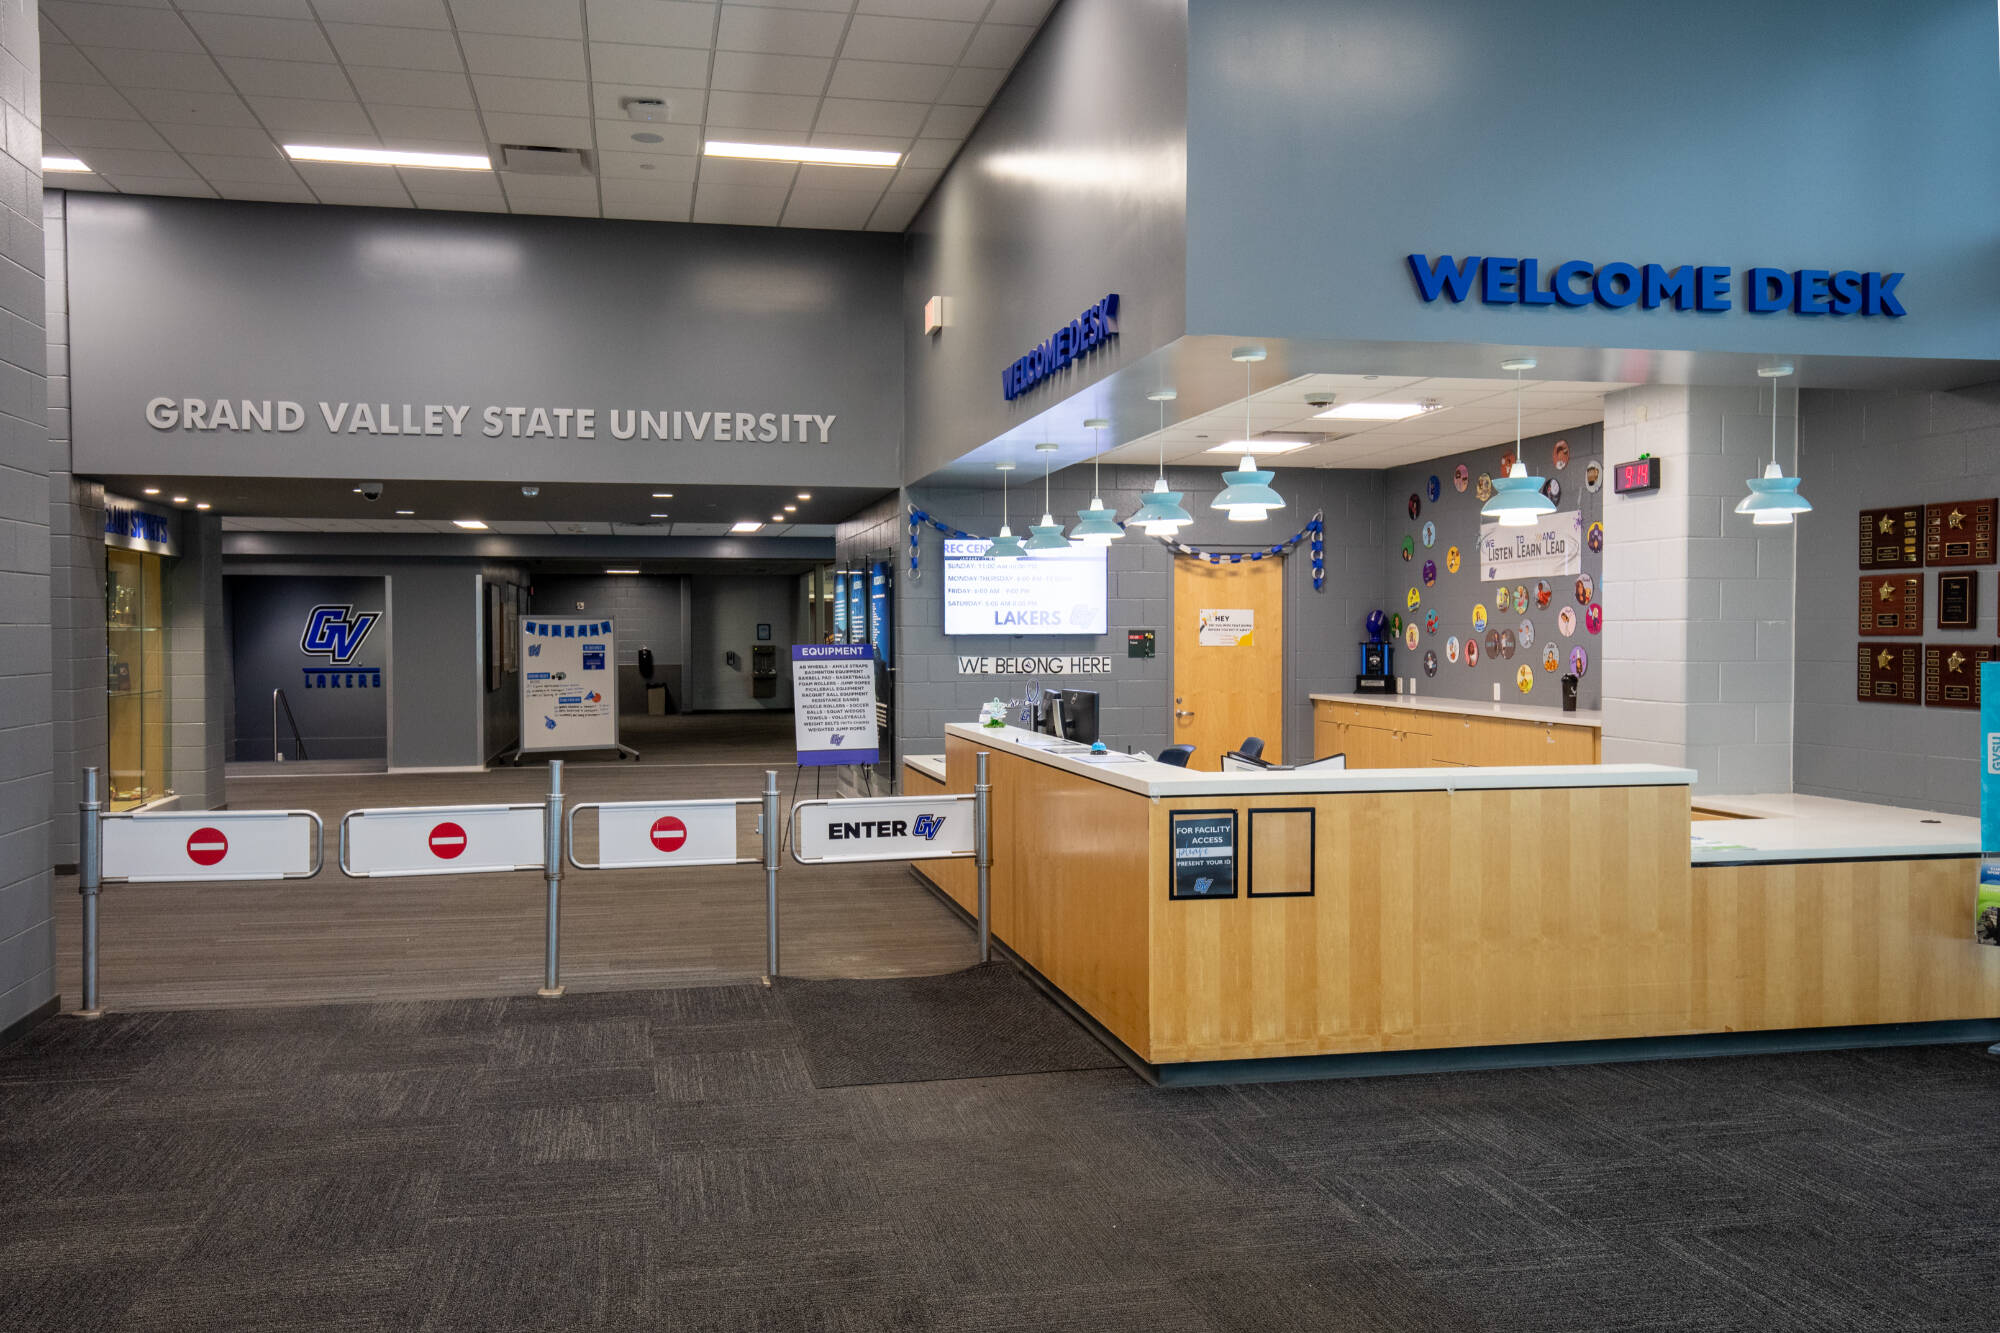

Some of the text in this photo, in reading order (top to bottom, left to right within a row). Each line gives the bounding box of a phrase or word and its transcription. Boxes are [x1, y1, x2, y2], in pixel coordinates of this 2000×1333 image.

[1408, 253, 1908, 317] WELCOME DESK
[1002, 293, 1120, 400] WELCOME DESK
[145, 397, 836, 443] GRAND VALLEY STATE UNIVERSITY
[944, 543, 964, 554] REC
[1488, 539, 1565, 562] LISTEN LEARN LEAD
[994, 610, 1062, 626] LAKERS
[300, 604, 383, 665] GV
[801, 646, 865, 657] EQUIPMENT
[959, 656, 1111, 674] WE BELONG HERE
[304, 673, 382, 689] LAKERS
[828, 813, 947, 841] ENTER GV
[1176, 825, 1231, 835] FOR FACILITY
[1191, 836, 1223, 845] ACCESS
